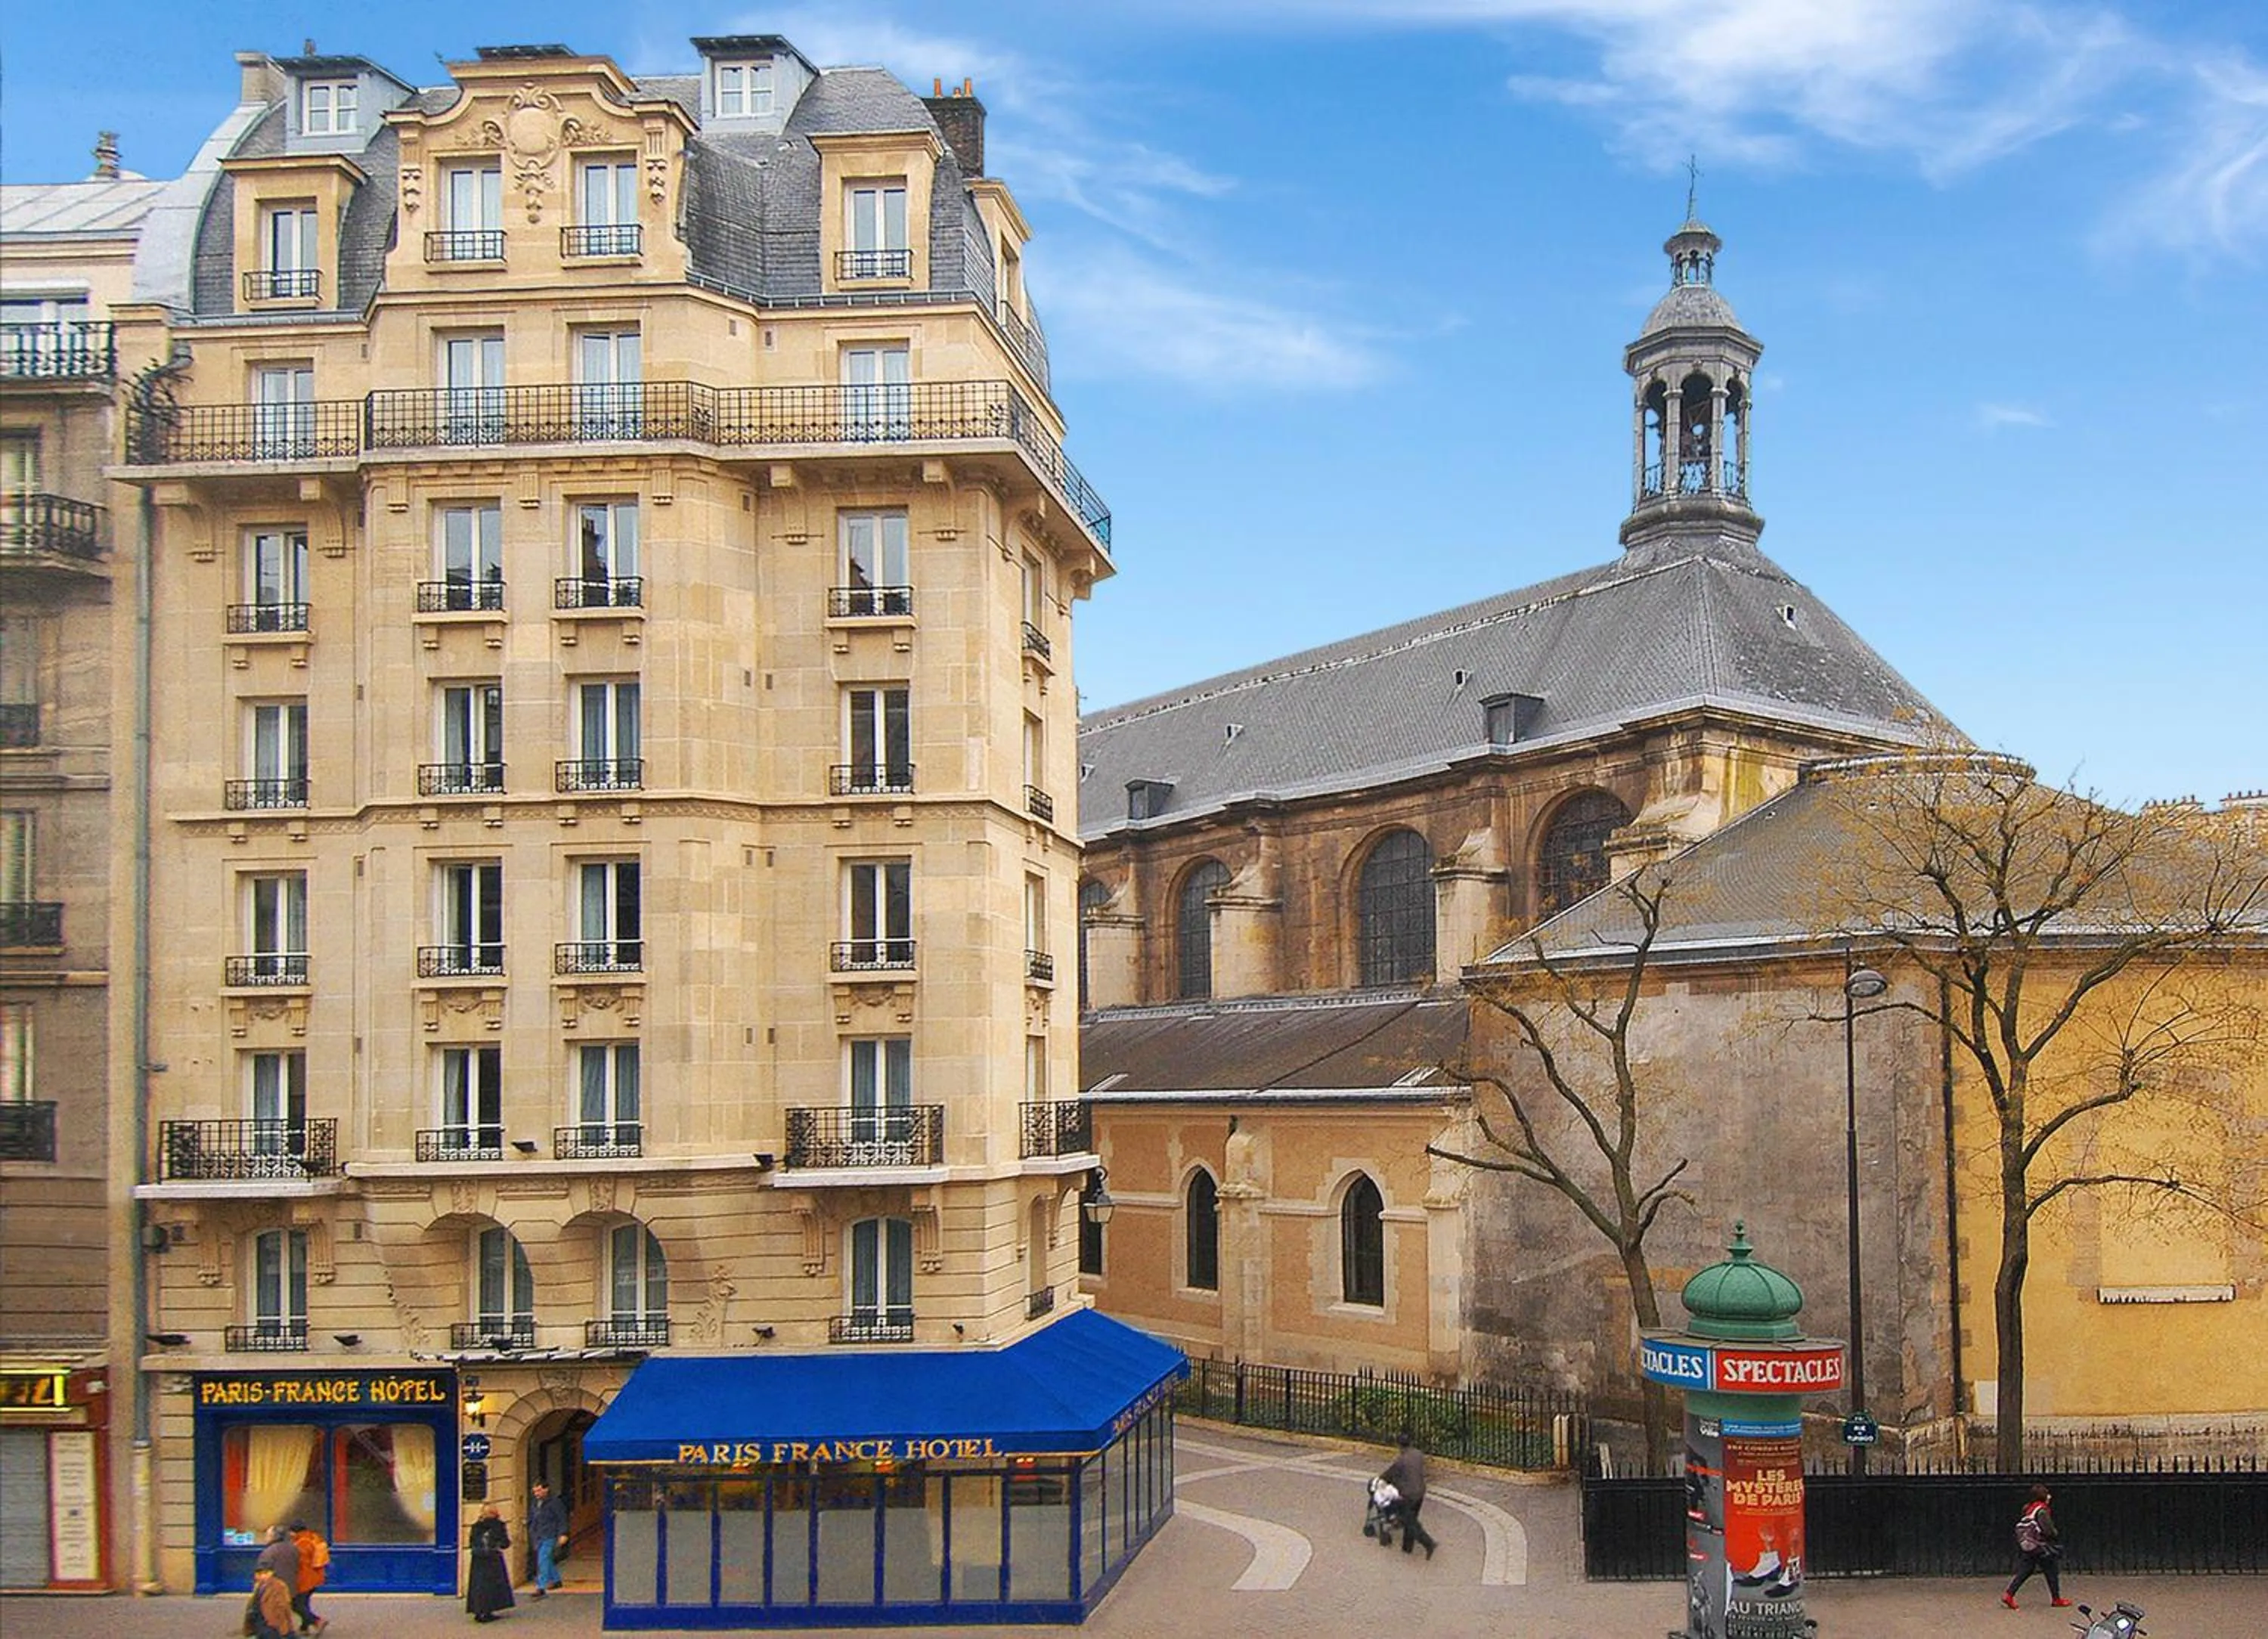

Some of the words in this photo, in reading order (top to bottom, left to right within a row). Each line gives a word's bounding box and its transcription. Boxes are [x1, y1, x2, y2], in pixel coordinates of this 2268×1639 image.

[1723, 1357, 1840, 1383] SPECTACLES
[201, 1380, 361, 1404] PARIS-FRANCE
[370, 1375, 446, 1402] HÔTEL
[678, 1442, 761, 1465] PARIS
[773, 1439, 894, 1464] FRANCE
[906, 1438, 1002, 1460] HOTEL
[1756, 1469, 1786, 1482] LES
[1733, 1492, 1758, 1506] DE
[1725, 1599, 1751, 1614] AU
